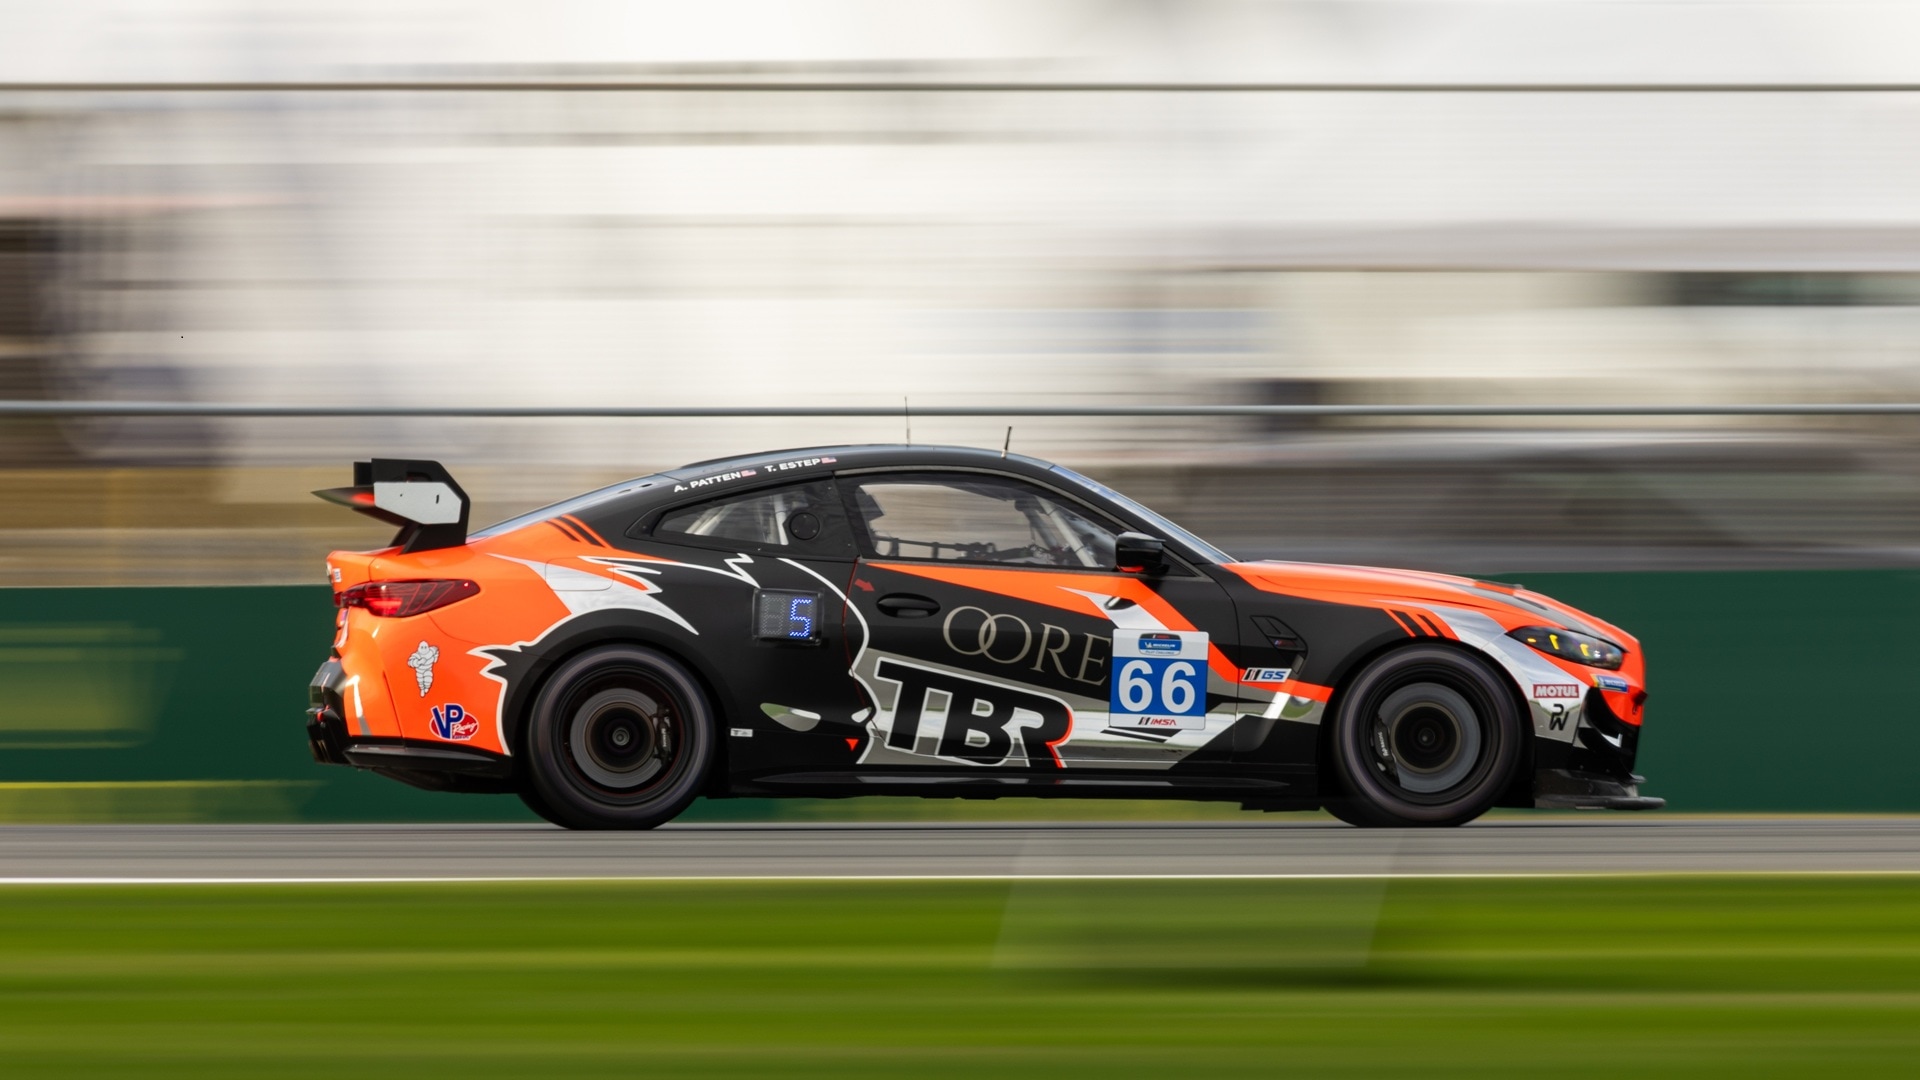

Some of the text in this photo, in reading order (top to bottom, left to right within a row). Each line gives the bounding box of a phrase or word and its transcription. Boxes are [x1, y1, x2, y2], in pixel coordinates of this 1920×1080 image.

[764, 458, 820, 473] T. ESTEP
[673, 471, 741, 493] A. PATTEN
[789, 598, 812, 637] 5
[1261, 670, 1287, 680] GS
[1118, 659, 1196, 714] 66
[1535, 685, 1578, 697] MOTUL
[431, 703, 464, 739] VP
[873, 656, 1074, 769] TBR
[1150, 717, 1177, 726] IMSA
